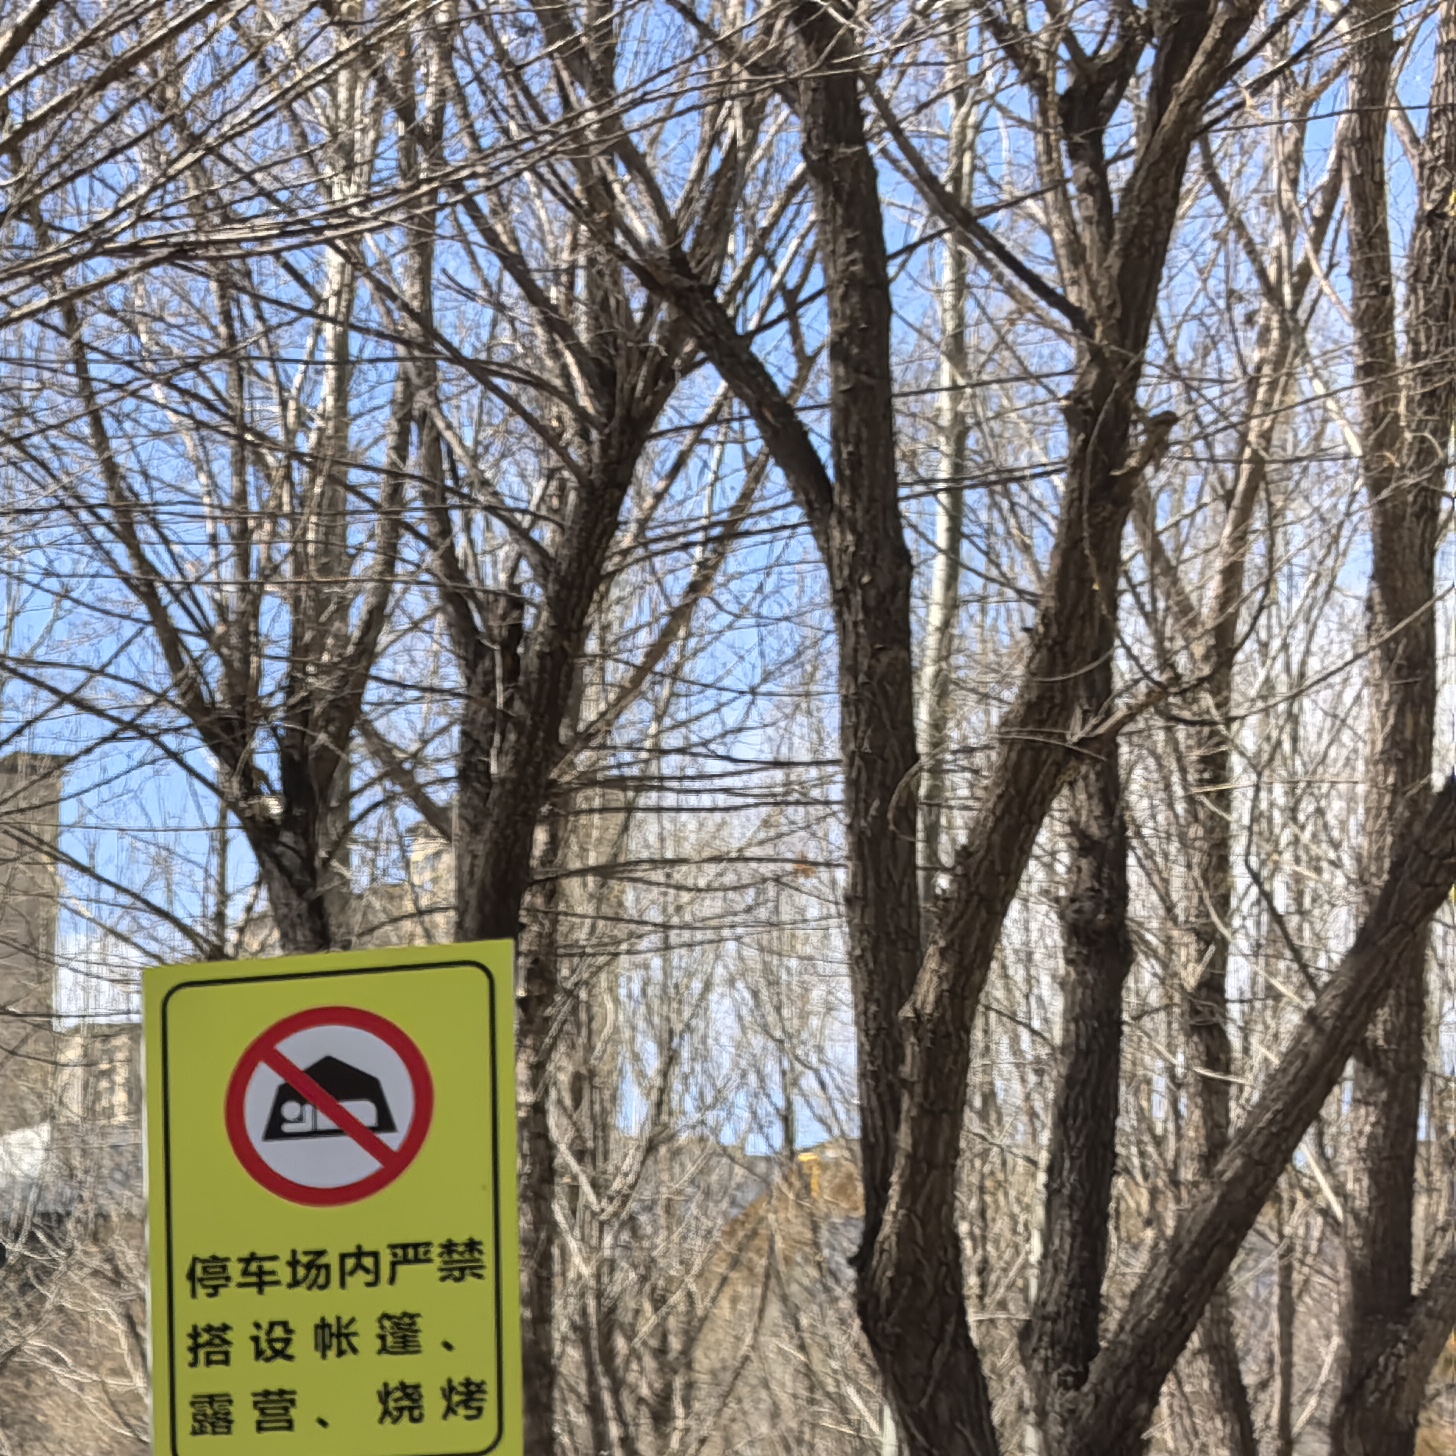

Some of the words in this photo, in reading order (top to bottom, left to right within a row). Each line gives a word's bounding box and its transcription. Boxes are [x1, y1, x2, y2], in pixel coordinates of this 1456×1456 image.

[186, 1237, 487, 1300] 停车场内严禁
[187, 1311, 456, 1369] 搭设帐篷、
[190, 1376, 489, 1438] 露营、烧烤
